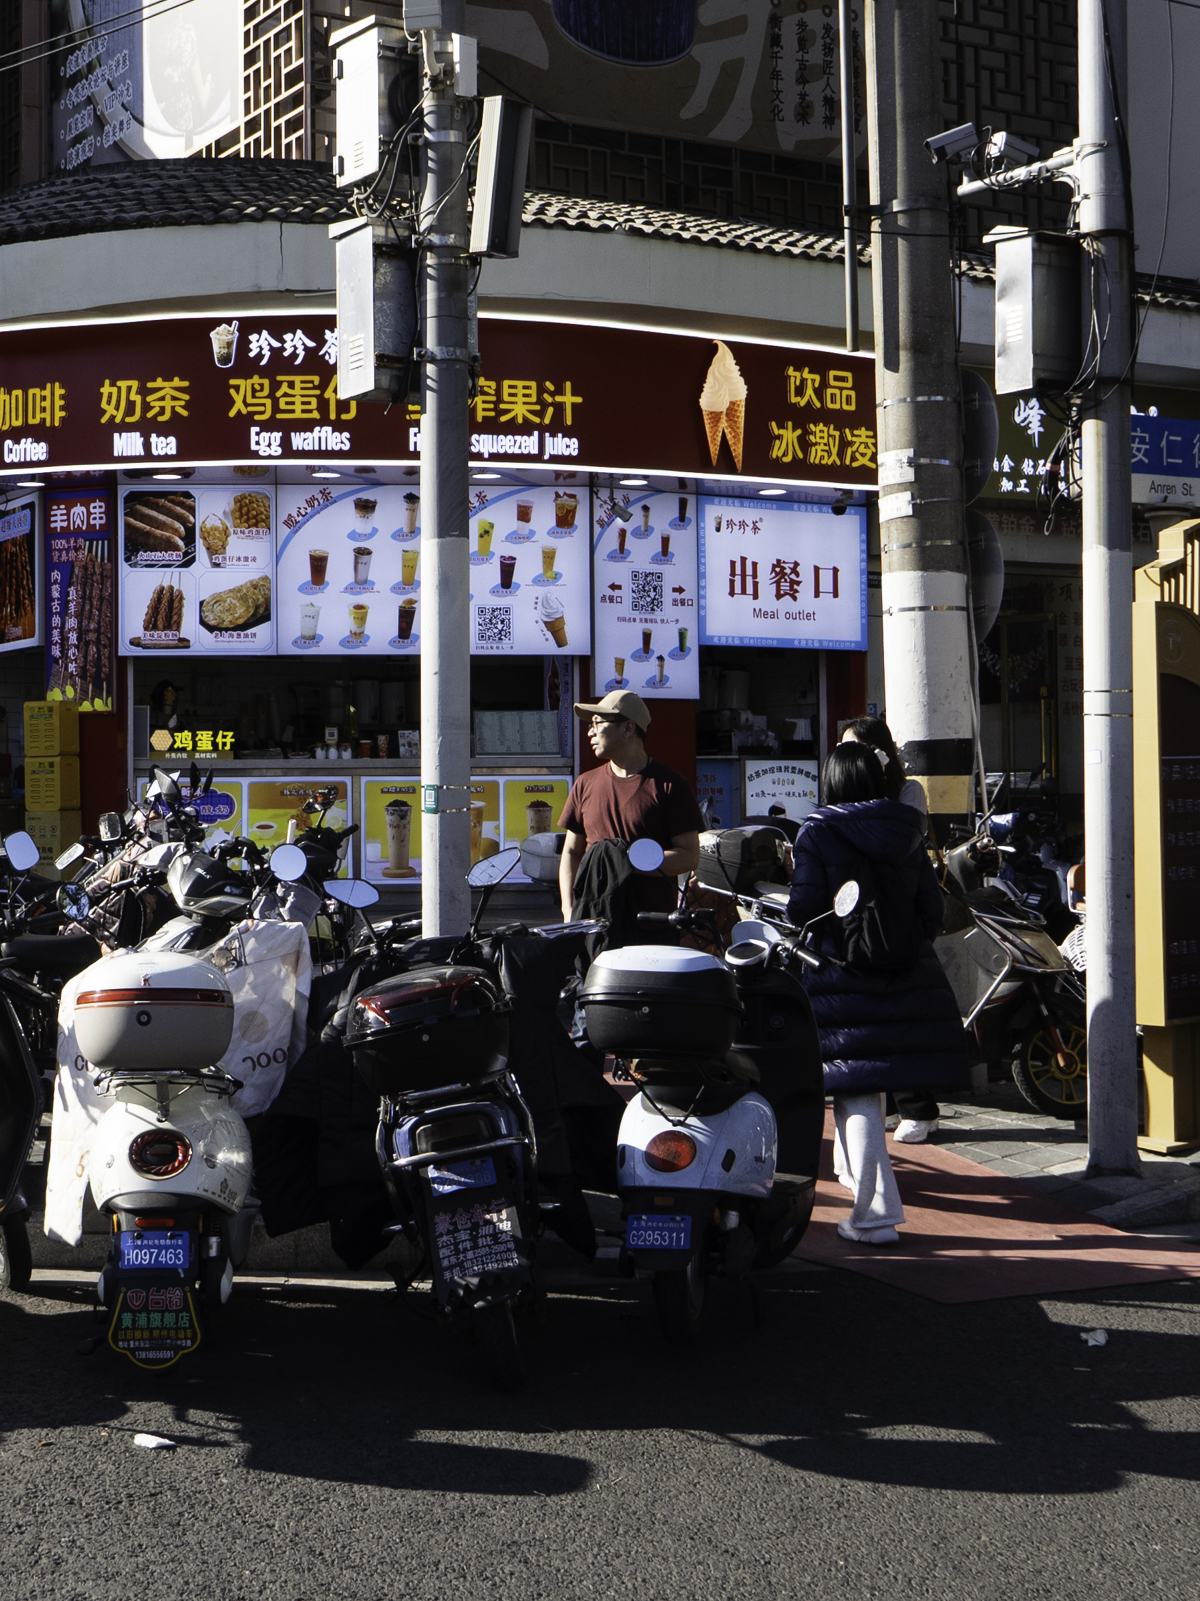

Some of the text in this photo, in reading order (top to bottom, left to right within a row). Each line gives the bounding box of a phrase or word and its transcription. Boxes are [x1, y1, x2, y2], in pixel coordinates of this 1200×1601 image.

[795, 18, 810, 126] 步览古今艺术
[821, 22, 835, 130] 发扬匠人精神
[786, 366, 857, 411] 饮品
[100, 376, 190, 424] 奶茶
[406, 378, 584, 427] 榨果汁
[1013, 397, 1046, 449] 峰
[4, 439, 48, 463] Coffee
[113, 433, 177, 456] Milk tea
[250, 426, 350, 457] Egg waffles
[471, 432, 579, 460] squeezed juice
[769, 421, 877, 469] 冰激凌
[1000, 477, 1031, 494] 加工
[1149, 480, 1195, 497] Anren St.
[50, 498, 107, 532] 羊肉串
[282, 487, 333, 530] 暖心奶茶
[596, 494, 631, 530] 新品市
[743, 500, 777, 510] Welcome
[726, 518, 762, 535] 珍珍茶
[51, 537, 85, 550] 100%羊肉
[52, 550, 85, 563] 货真价实
[728, 555, 840, 602] 出餐口
[600, 594, 623, 604] 点餐口
[672, 598, 694, 607] 出餐口
[753, 608, 816, 621] Meal outlet
[743, 637, 777, 646] Welcome
[822, 640, 856, 649] Welcome
[174, 730, 235, 751] 鸡蛋仔
[434, 1198, 508, 1236] 家仓车行
[439, 1232, 513, 1258] 配件批发
[628, 1231, 683, 1245] G295311
[124, 1249, 184, 1265] H097463
[463, 1251, 517, 1268] 18321224908
[149, 1287, 184, 1309] 台铃
[121, 1312, 190, 1328] 黄浦旗舰店
[118, 1330, 150, 1340] 以旧换新
[135, 1350, 175, 1359] 13816556591
